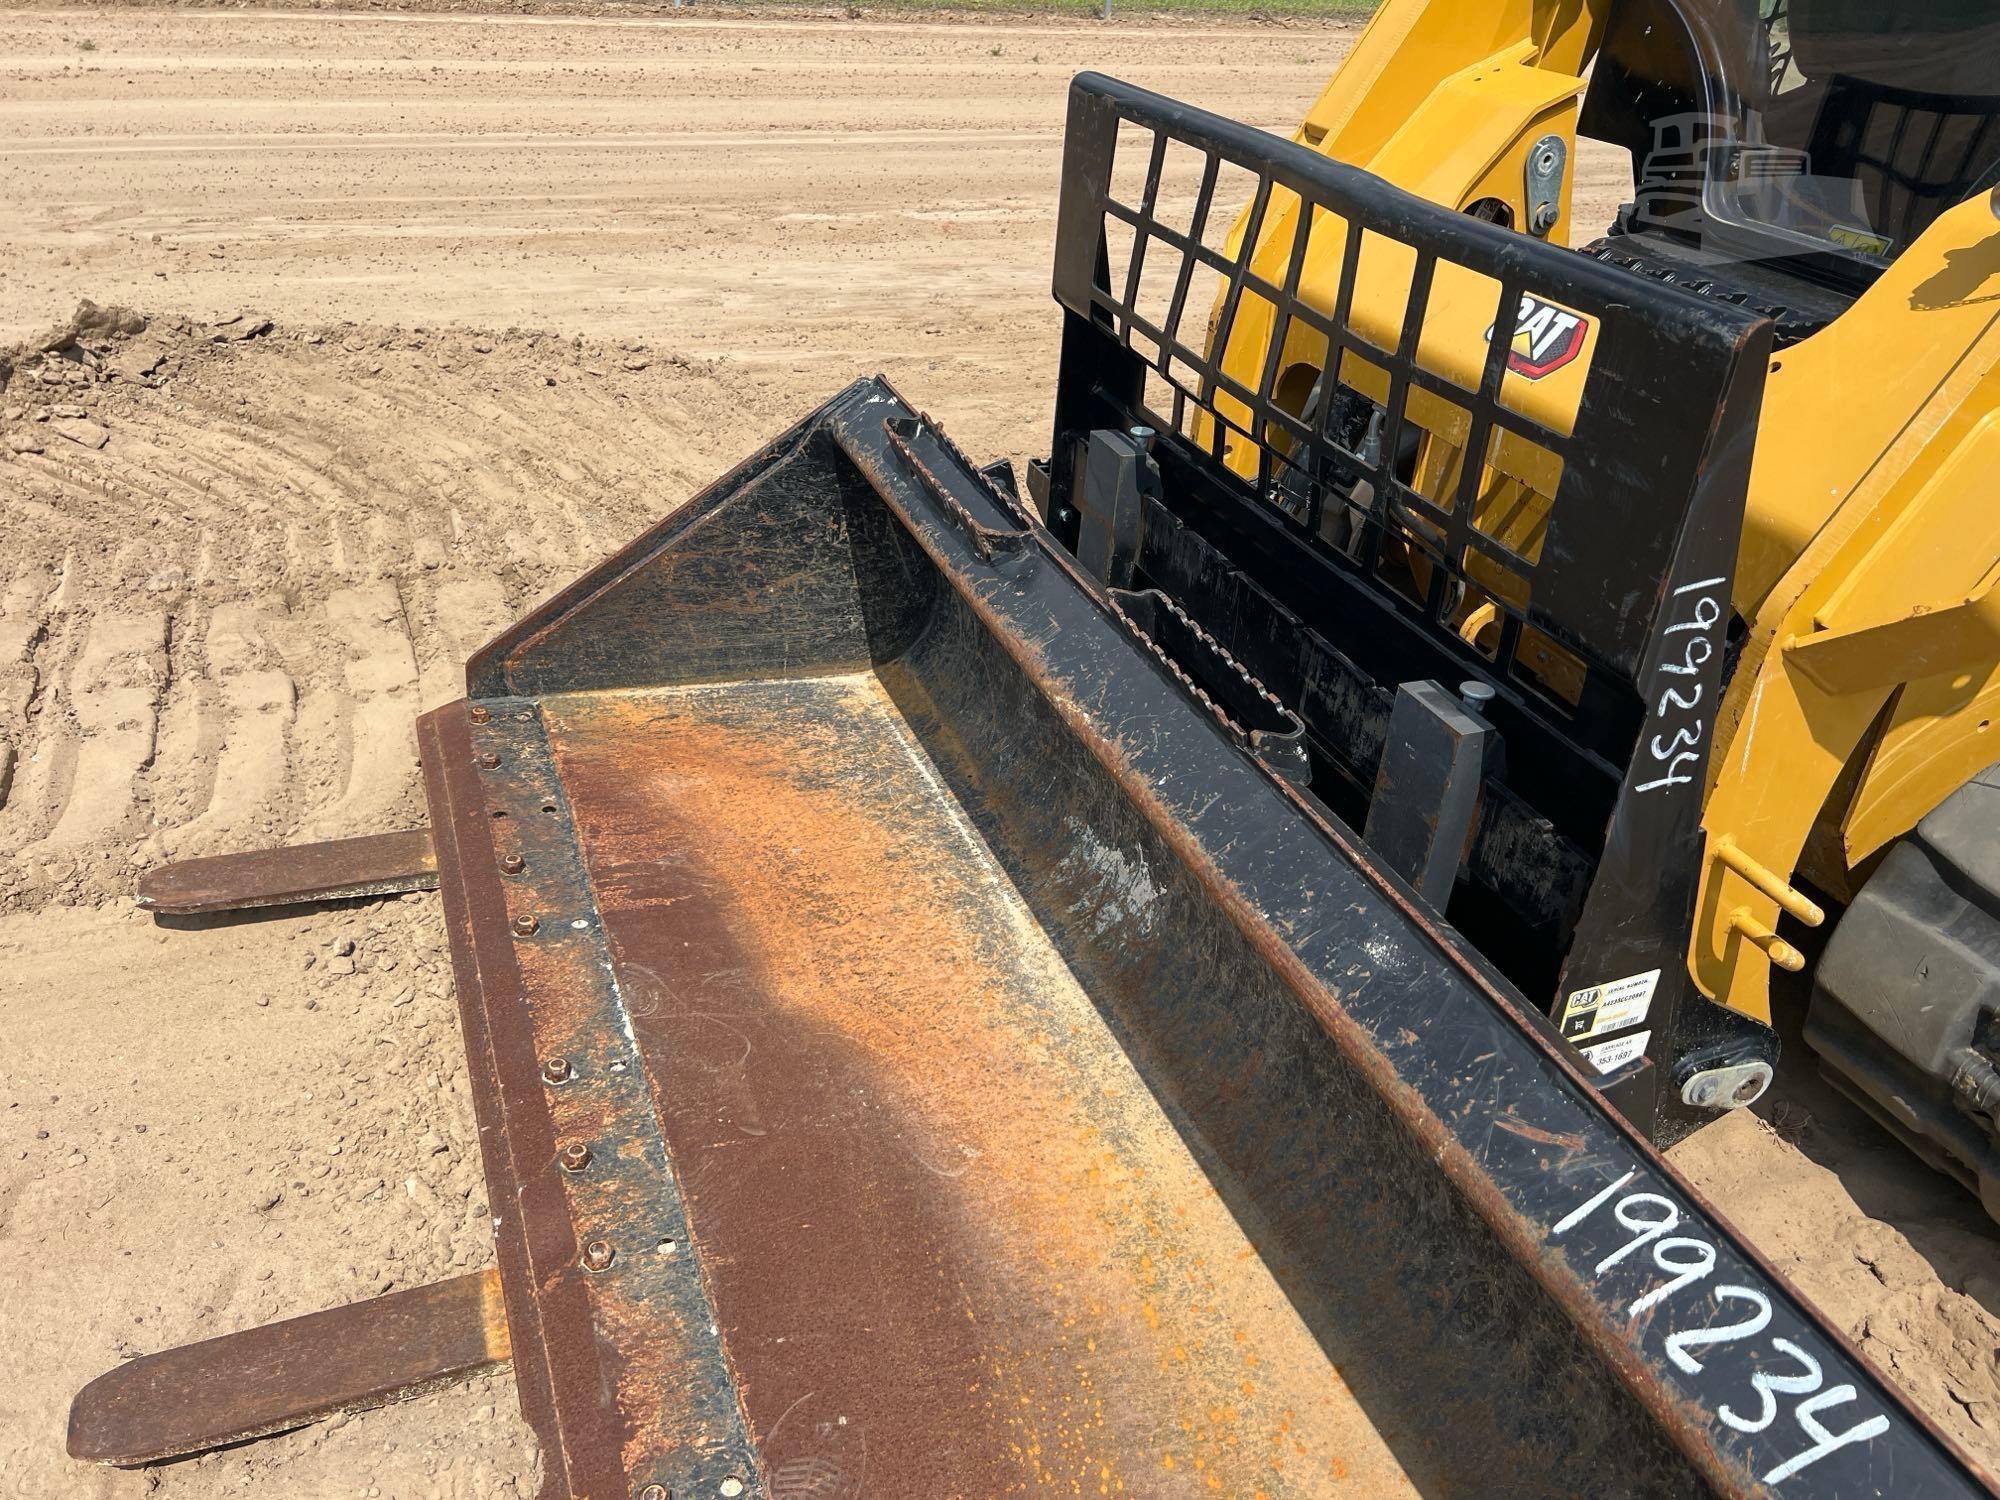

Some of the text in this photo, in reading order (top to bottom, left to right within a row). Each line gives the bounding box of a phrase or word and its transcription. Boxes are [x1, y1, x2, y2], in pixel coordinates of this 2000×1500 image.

[1635, 576, 1726, 793] 199234
[1571, 989, 1597, 1008] CAT
[1553, 1165, 1890, 1485] 199234
